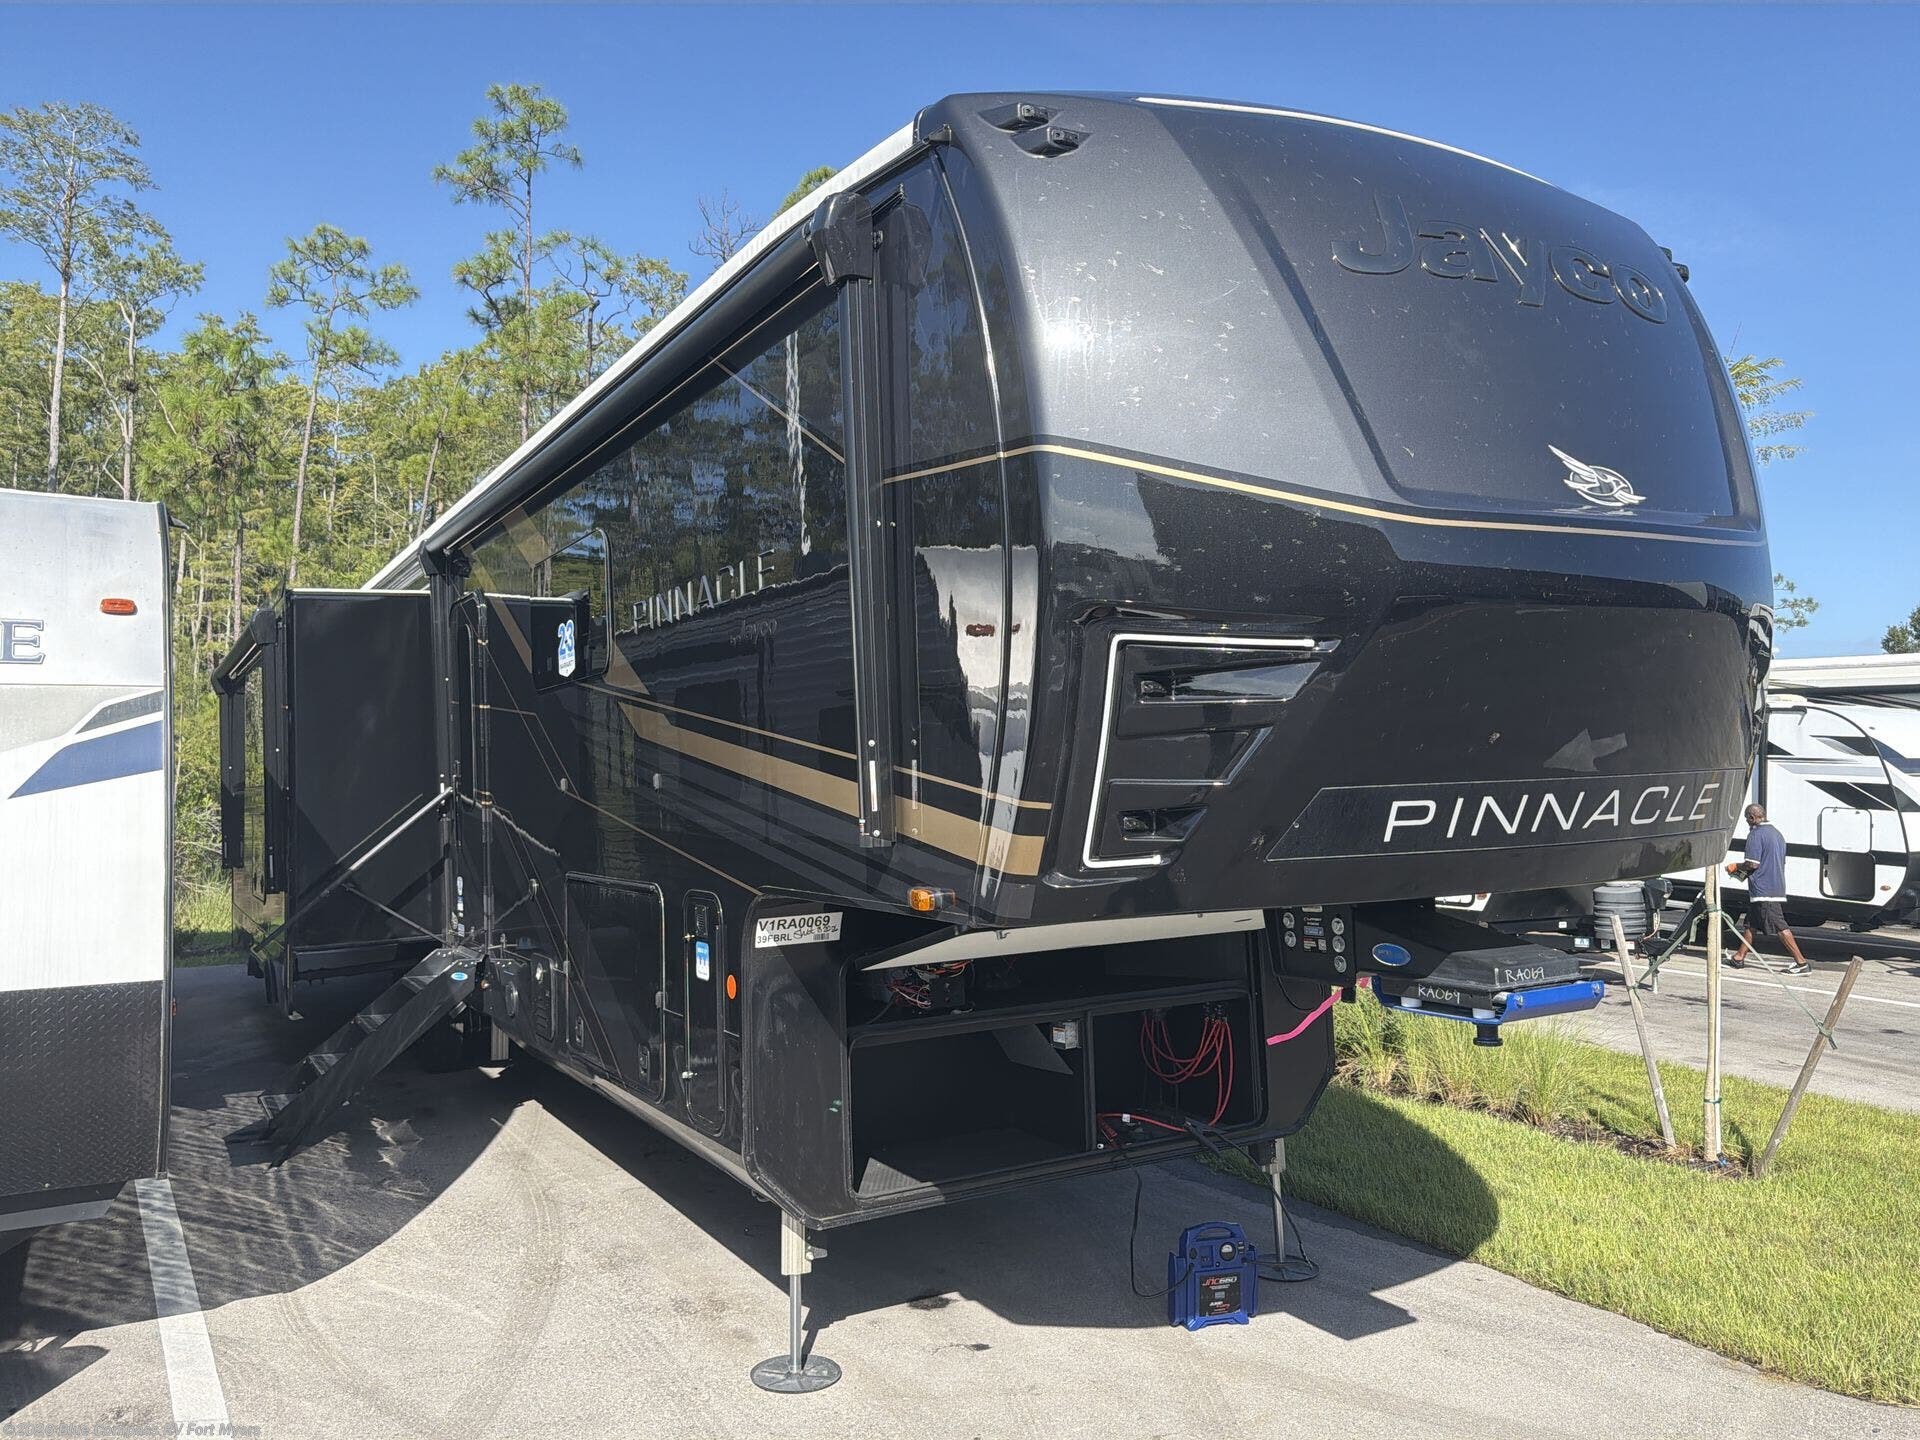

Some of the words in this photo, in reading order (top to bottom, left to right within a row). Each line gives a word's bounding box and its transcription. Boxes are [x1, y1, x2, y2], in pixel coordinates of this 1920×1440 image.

[1330, 188, 1669, 325] Jayco
[632, 548, 776, 635] PINNACLE
[0, 618, 46, 665] E
[1383, 782, 1720, 843] PINNACLE
[757, 933, 793, 944] 39FBRL
[758, 915, 831, 932] V1RA0069
